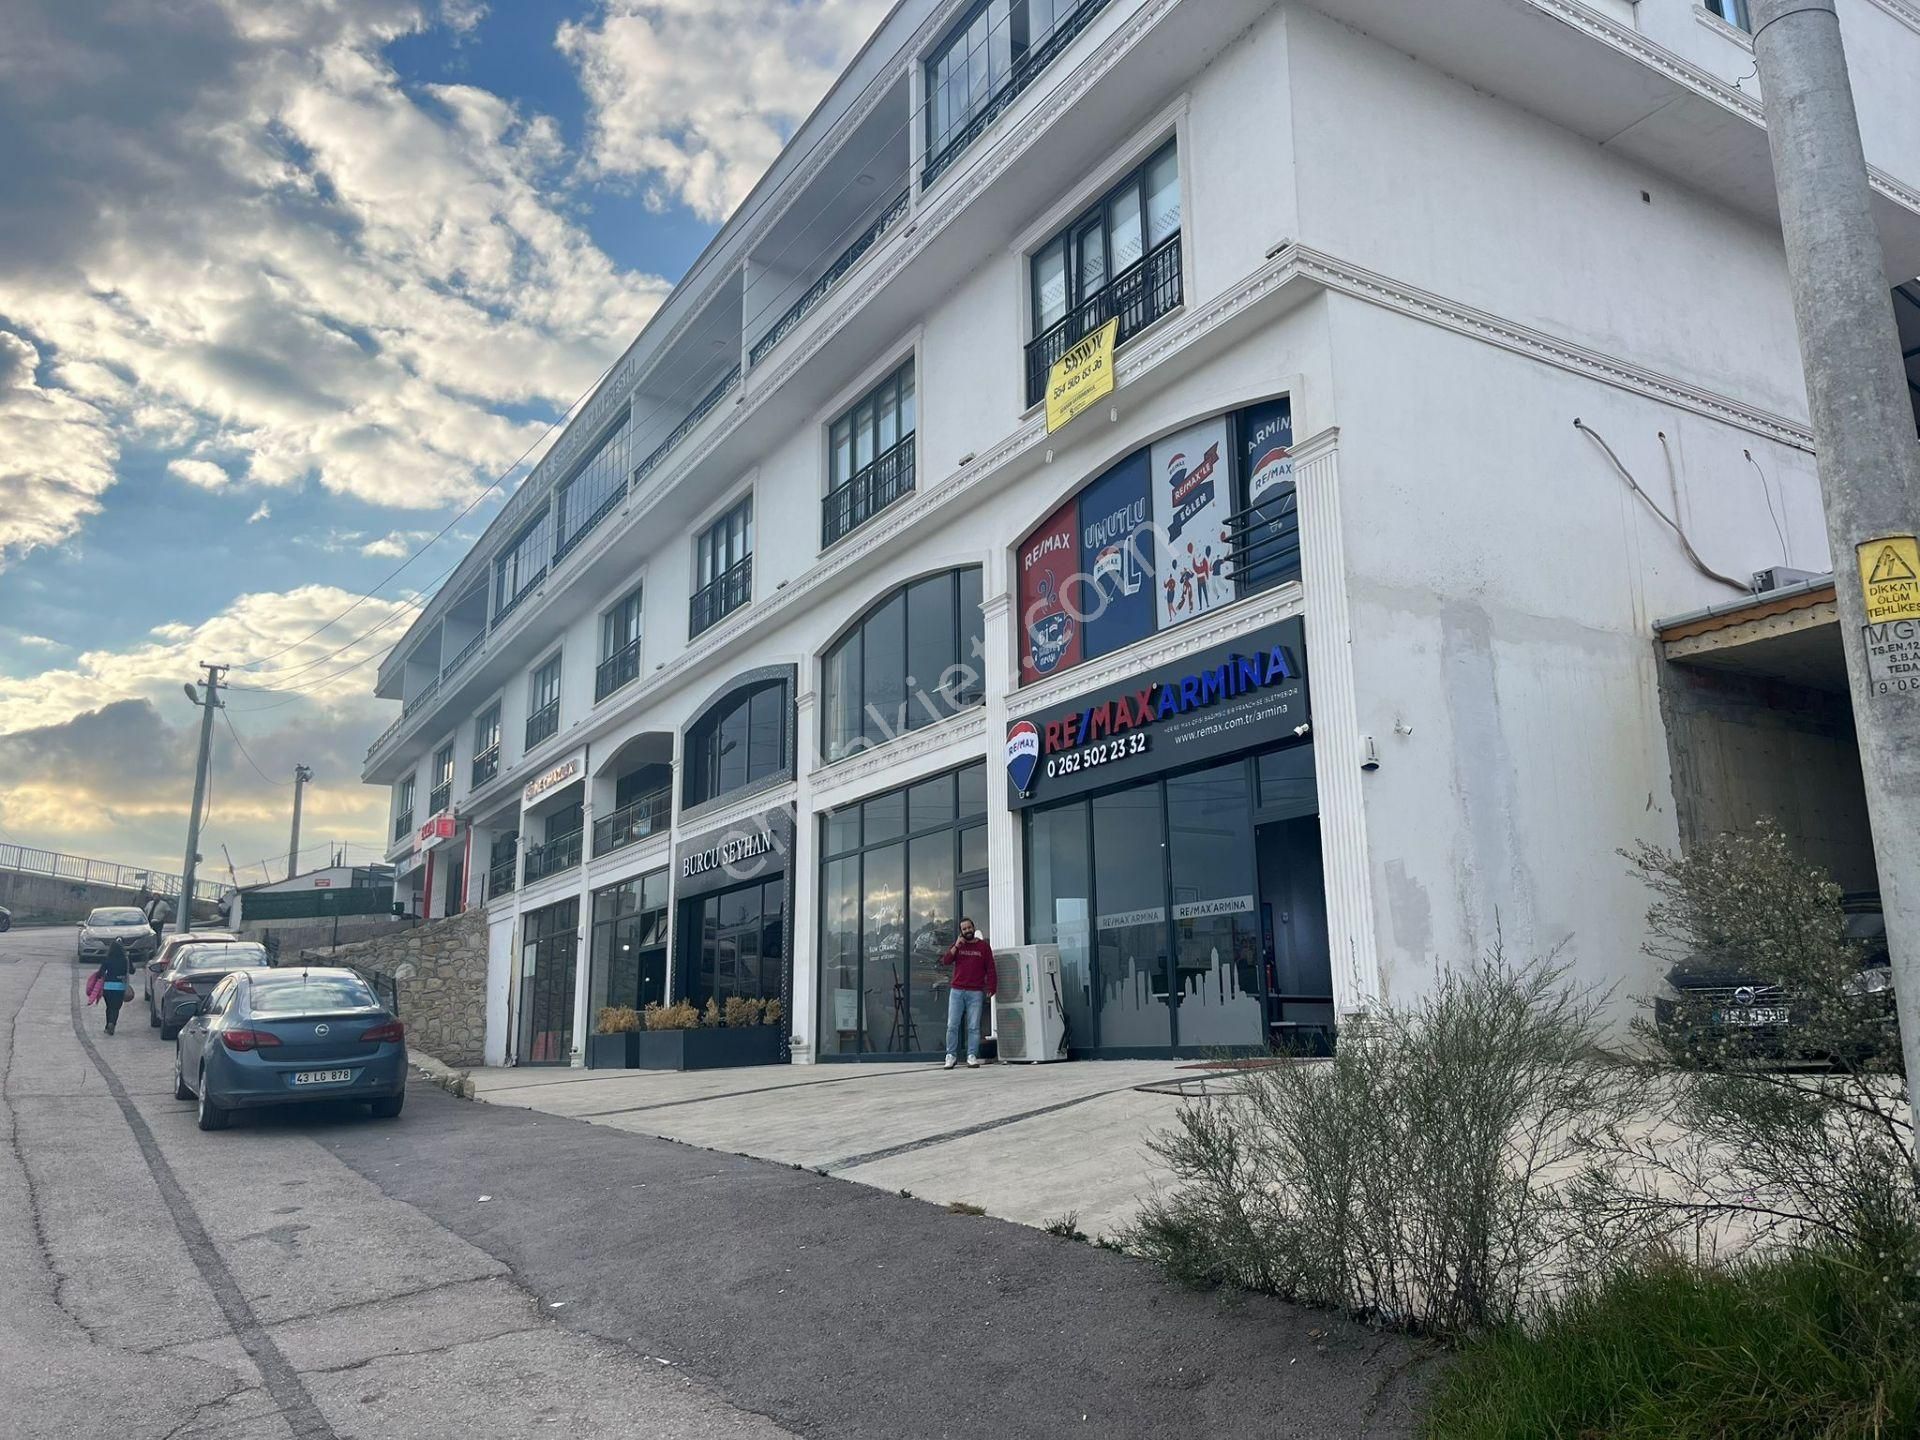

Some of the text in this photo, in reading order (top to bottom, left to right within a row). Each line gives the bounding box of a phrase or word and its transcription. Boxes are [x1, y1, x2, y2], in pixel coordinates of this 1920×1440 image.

[1248, 416, 1292, 455] ARMİN
[1255, 464, 1292, 490] RE/MAX
[1025, 533, 1070, 571] RE/MAX
[1869, 582, 1912, 596] DİKKAT
[1877, 593, 1911, 605] ÖLÜM
[1045, 644, 1291, 754] RE/MAX ARMİNA
[1174, 703, 1288, 744] www.remax.com.tr/armina
[1009, 739, 1034, 756] RE/MAX
[1047, 732, 1145, 778] 0 262 502 23 32
[683, 829, 771, 877] BURCU SEYHAN
[1180, 905, 1211, 917] RE/MAX
[297, 1070, 349, 1082] 43 LG 878
